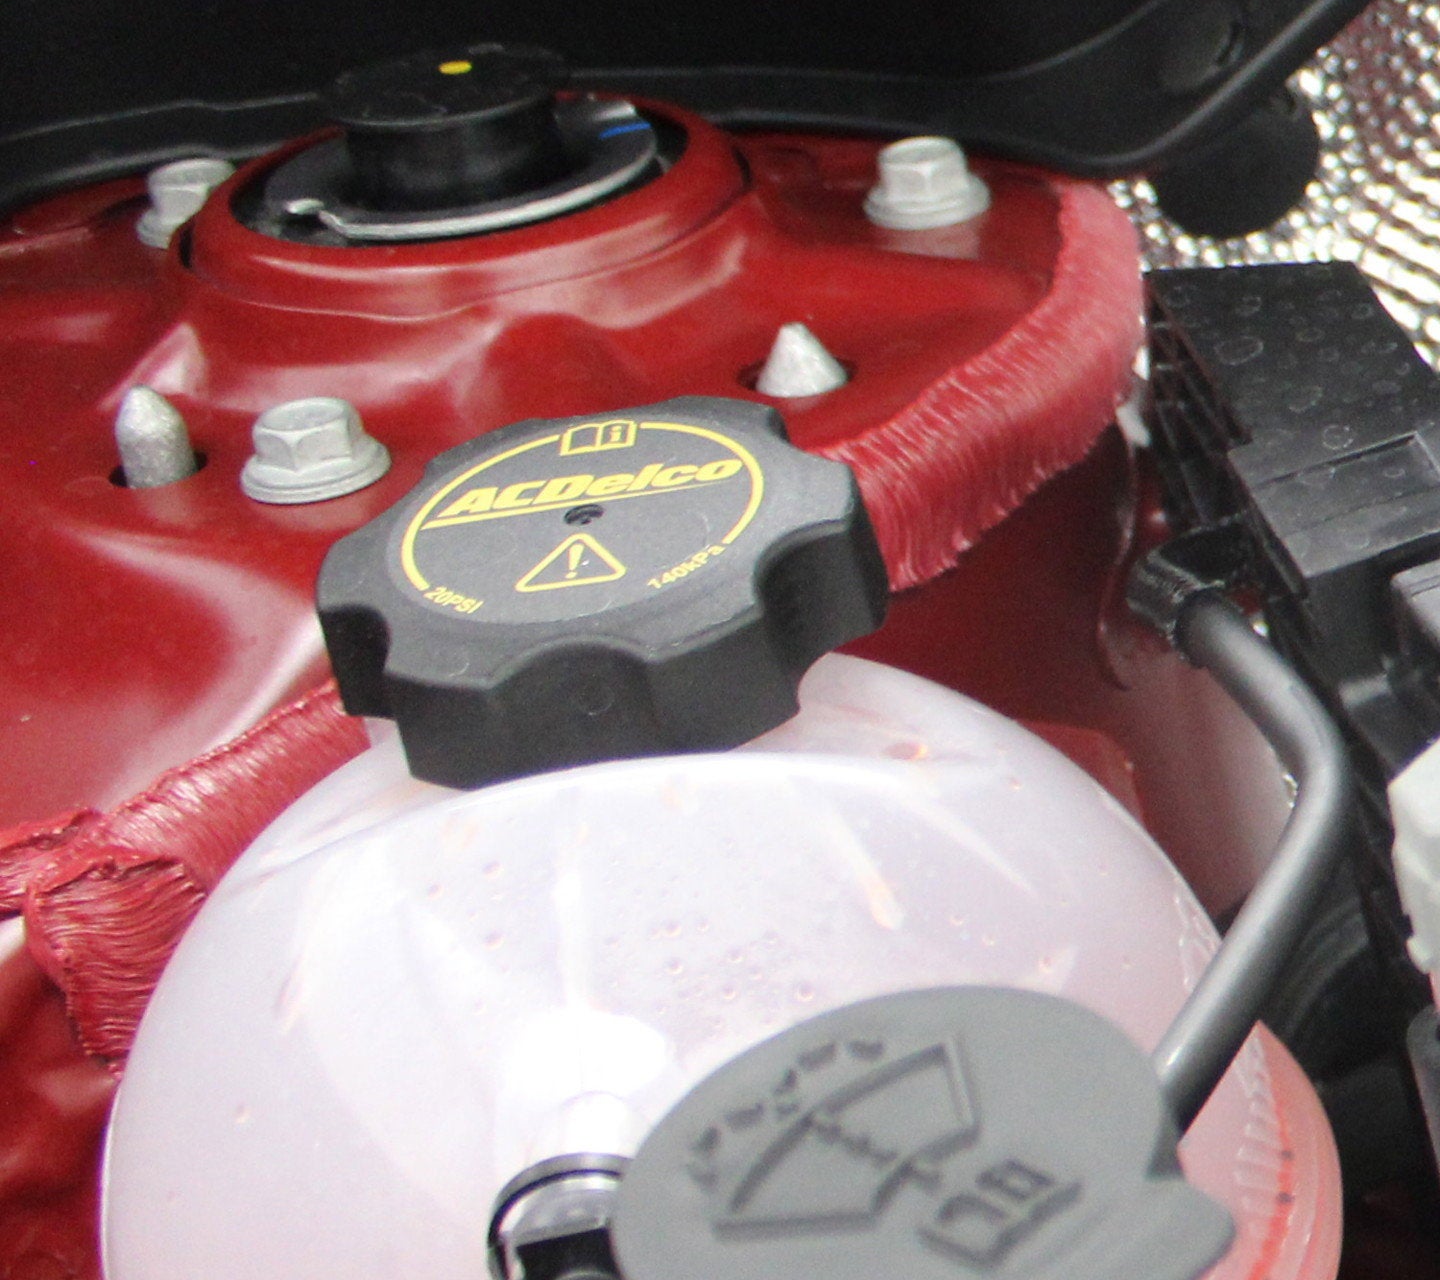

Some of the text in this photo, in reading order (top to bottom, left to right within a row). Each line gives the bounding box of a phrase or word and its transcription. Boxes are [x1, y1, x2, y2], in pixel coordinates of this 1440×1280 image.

[436, 458, 743, 519] ACDelco
[646, 542, 726, 590] 140kPa
[423, 585, 484, 613] 20PSI
